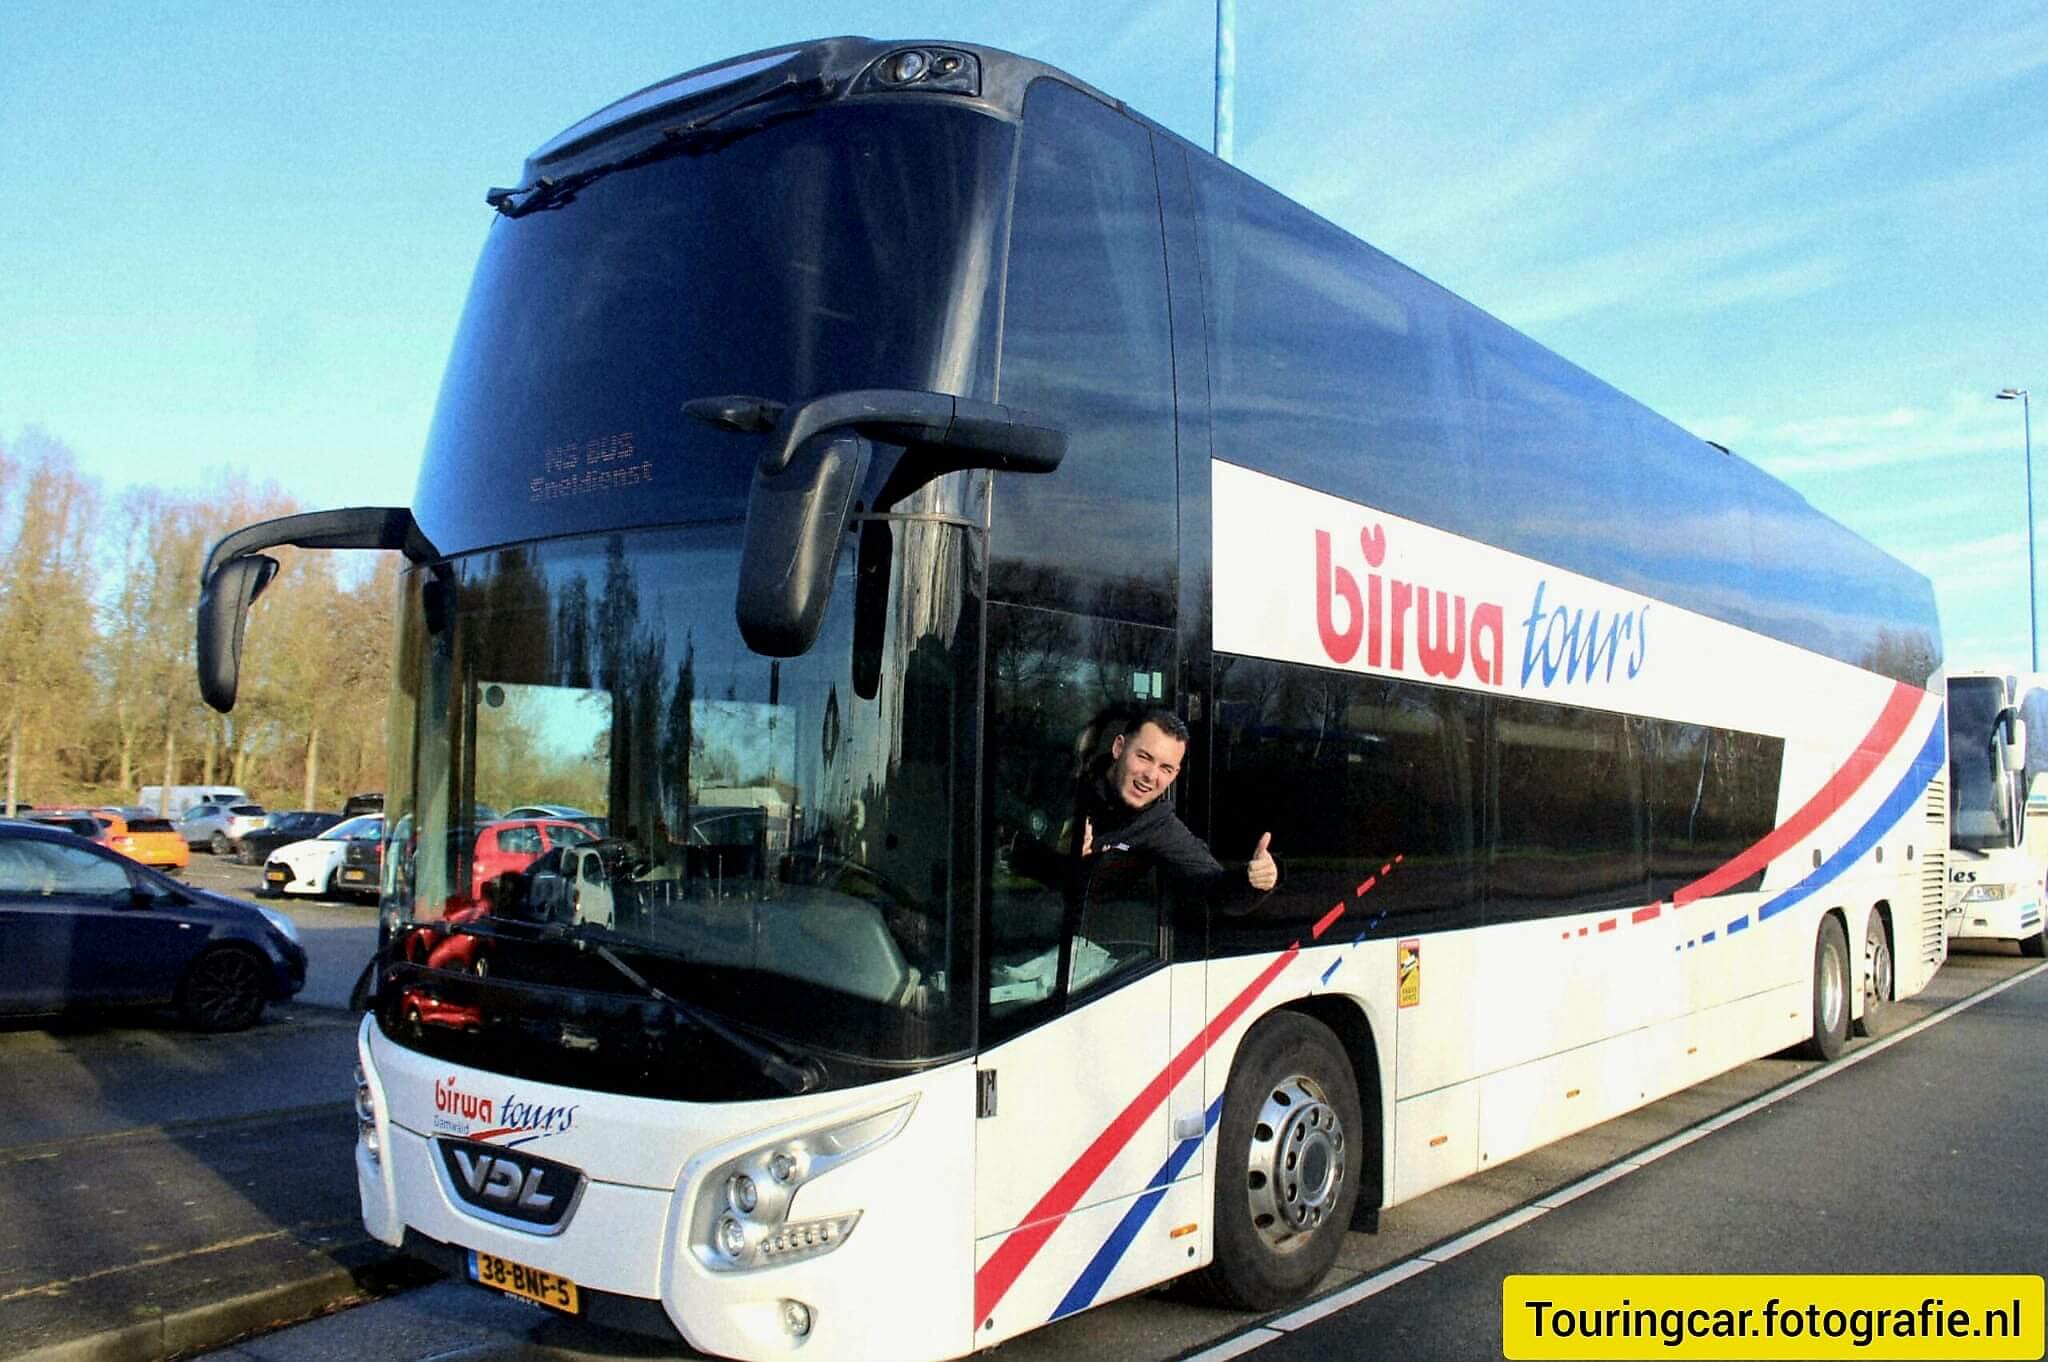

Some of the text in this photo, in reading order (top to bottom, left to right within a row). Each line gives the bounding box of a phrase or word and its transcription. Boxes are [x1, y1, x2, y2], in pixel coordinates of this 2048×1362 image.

[586, 431, 633, 465] BUS
[1315, 523, 1650, 689] birwa tours
[435, 1076, 580, 1132] birwa tours
[453, 1150, 554, 1207] VDL
[481, 1254, 570, 1306] 38-BNF-5
